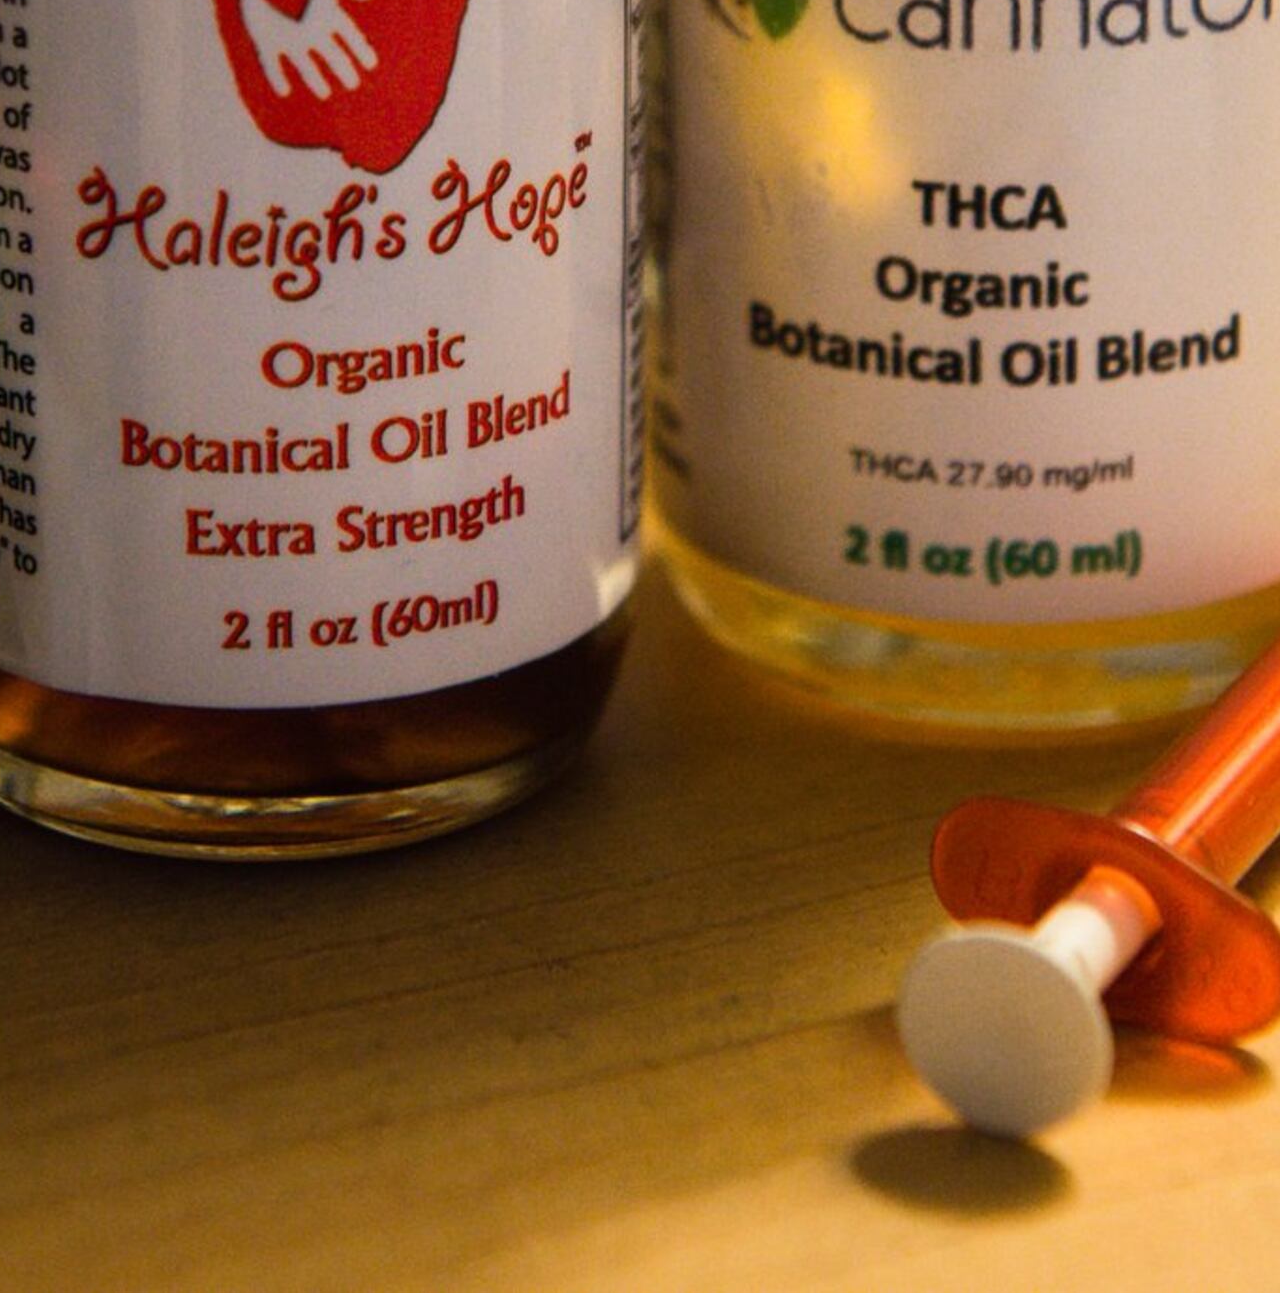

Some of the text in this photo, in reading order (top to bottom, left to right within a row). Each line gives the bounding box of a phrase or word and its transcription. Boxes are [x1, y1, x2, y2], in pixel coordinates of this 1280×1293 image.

[12, 26, 28, 49] a
[3, 102, 33, 131] of
[75, 165, 410, 301] Haleigh's
[912, 179, 1067, 231] THCA
[18, 231, 34, 255] a
[875, 254, 1091, 318] Organic
[19, 311, 36, 337] a
[748, 301, 1241, 388] Botanical Oil Blend
[261, 327, 466, 395] Organic
[120, 369, 571, 475] Botanical Oil Blend
[848, 447, 1134, 493] THCA 27.90 mg/ml
[185, 474, 526, 557] Extra Strength
[13, 543, 38, 576] to
[844, 524, 1143, 588] 2 fl oz (60 ml)
[220, 578, 500, 650] 2 fl oz (60ml)
